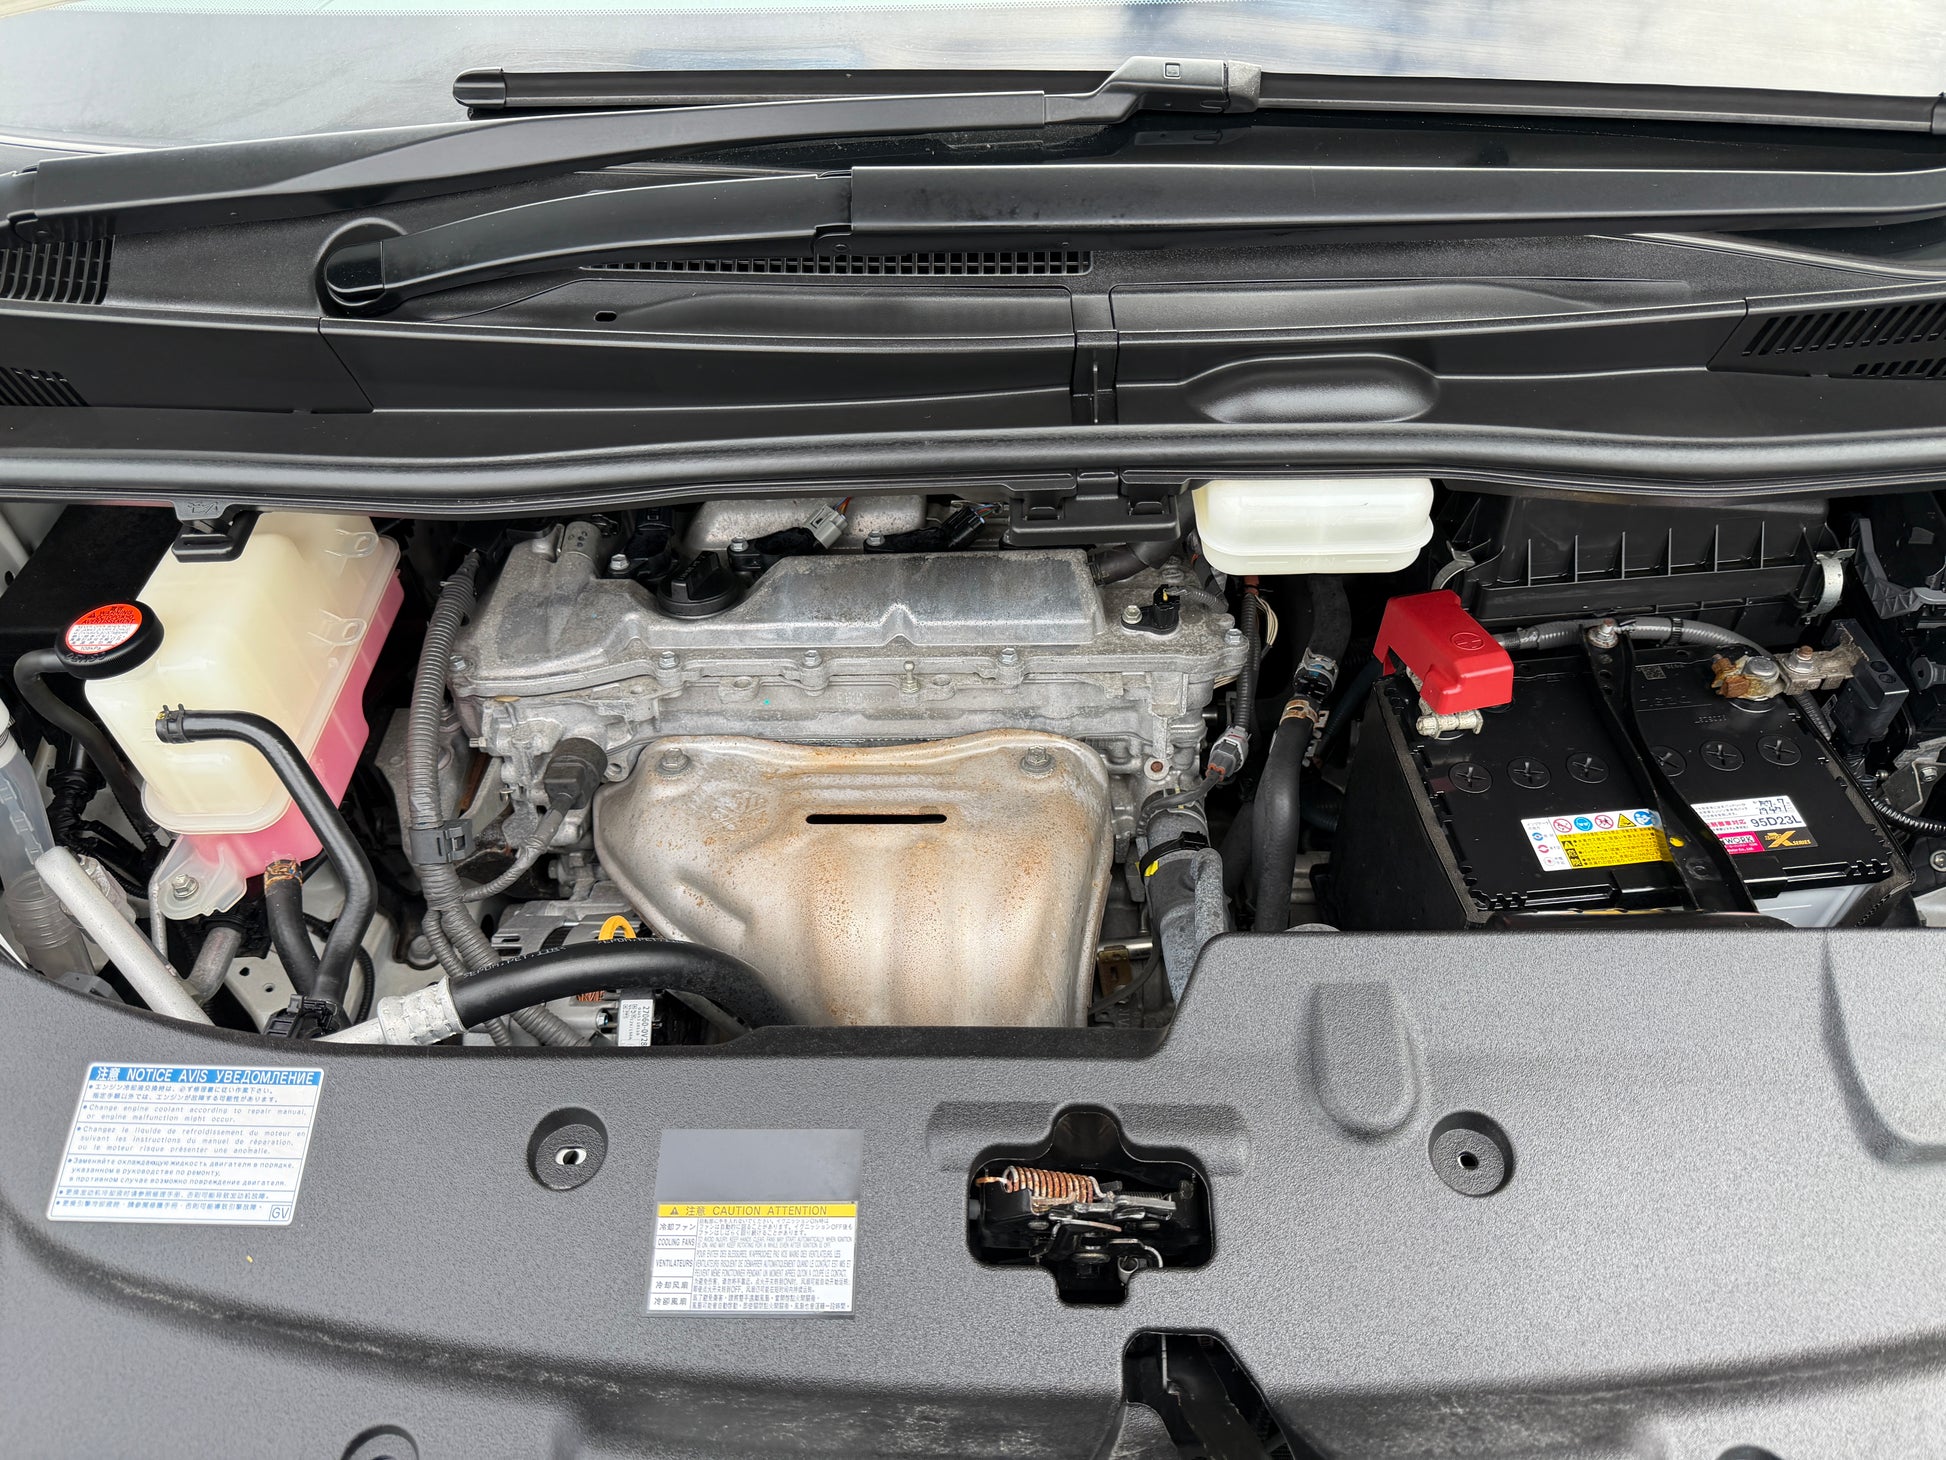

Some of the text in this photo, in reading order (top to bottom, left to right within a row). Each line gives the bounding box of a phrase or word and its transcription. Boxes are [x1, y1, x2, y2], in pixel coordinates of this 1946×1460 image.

[1750, 814, 1802, 828] 95D23L
[96, 1067, 314, 1085] 注意 NOTICE AVIS УВЕДОМЛЕНИЕ
[89, 1103, 118, 1111] Change
[271, 1207, 289, 1218] GV
[685, 1205, 827, 1216] 注意 CAUTION ATTENTION
[659, 1223, 697, 1231] 冷却ファン
[657, 1238, 680, 1247] COOLING
[681, 1238, 696, 1247] FANS
[656, 1259, 694, 1268] VENTILATEURS
